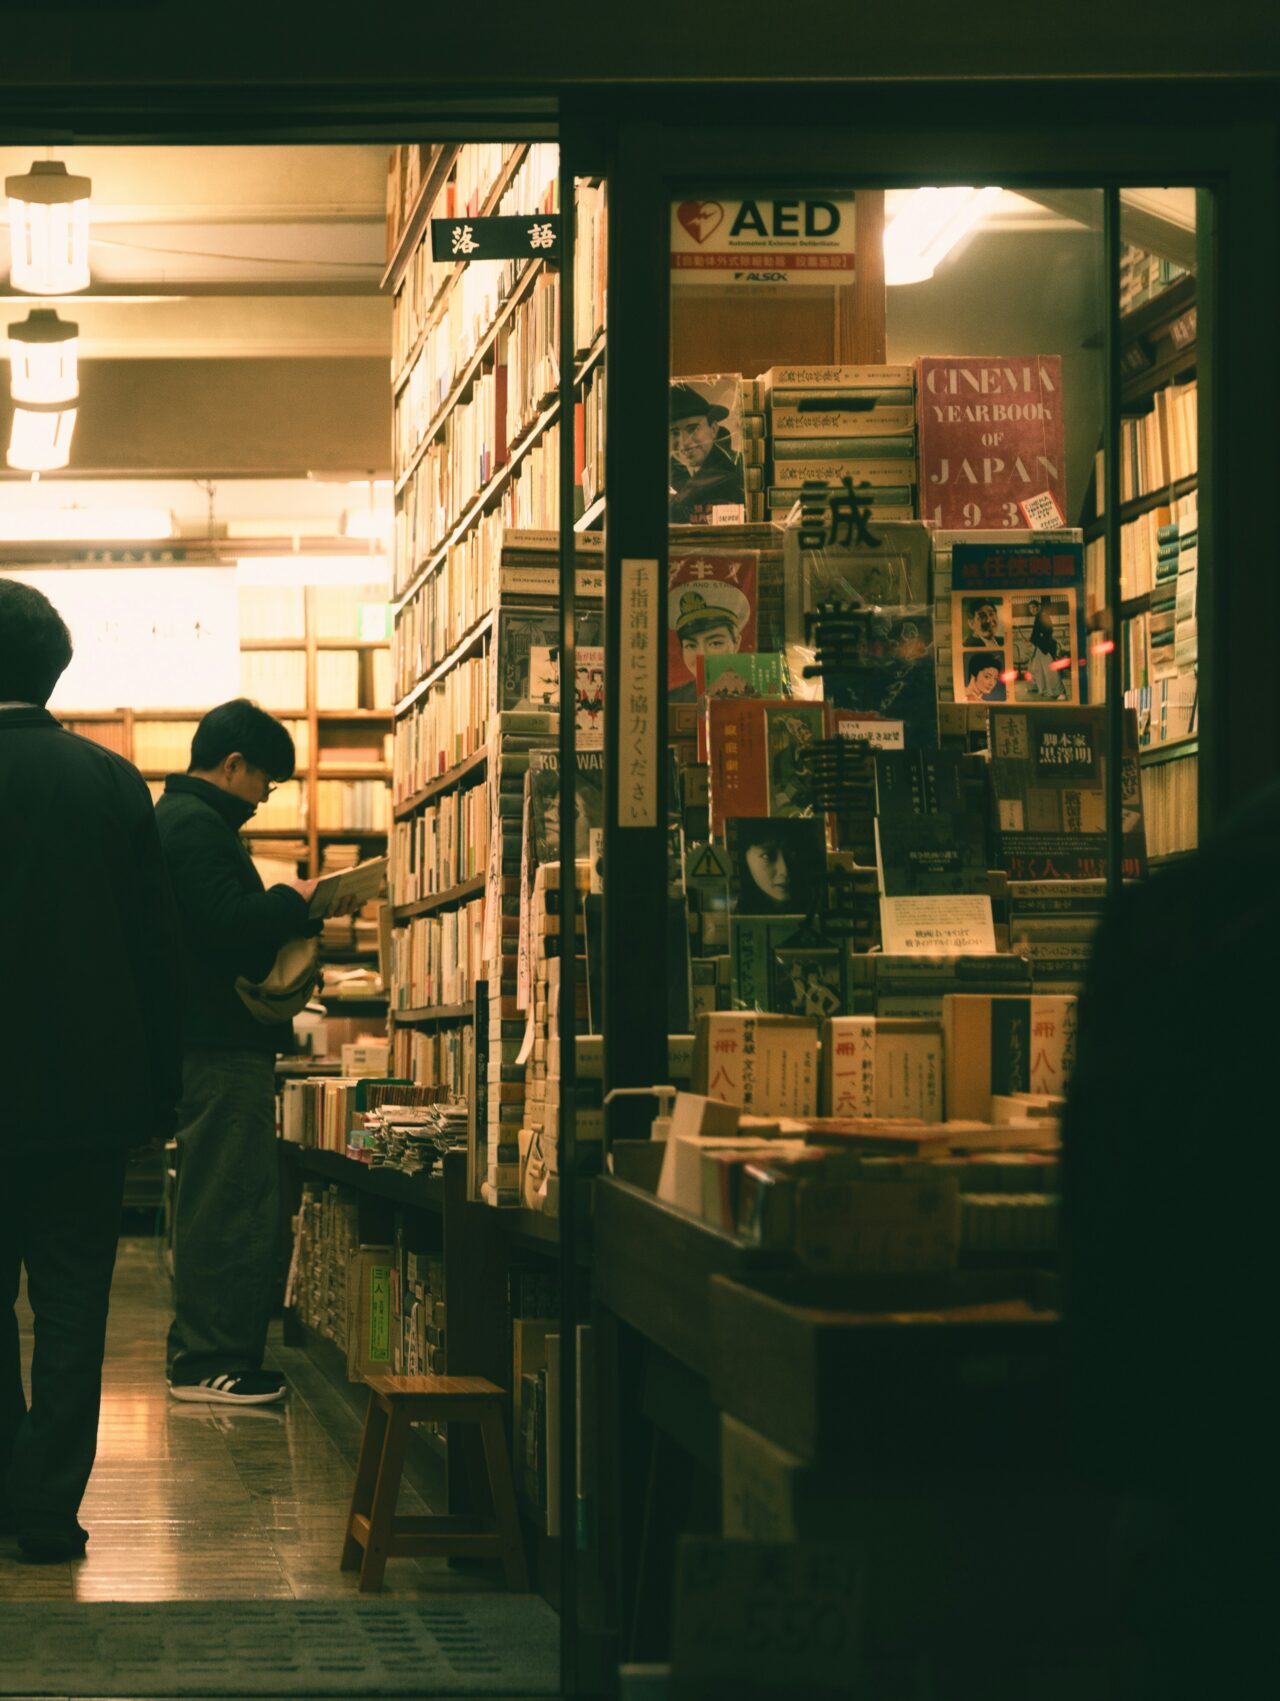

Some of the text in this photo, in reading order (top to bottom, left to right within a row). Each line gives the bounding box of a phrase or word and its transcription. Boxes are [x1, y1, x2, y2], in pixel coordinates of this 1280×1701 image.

[730, 200, 841, 237] AED
[451, 222, 557, 254] 落語
[746, 272, 787, 281] ALSOK
[927, 367, 1055, 394] CINEMA
[933, 404, 1059, 423] YEARBOOK
[981, 433, 1004, 447] OF
[931, 456, 1058, 485] JAPAN
[630, 566, 650, 821] 手指消毒にご協力ください
[1043, 733, 1087, 748] 脚本家
[1039, 747, 1093, 765] 黒澤明
